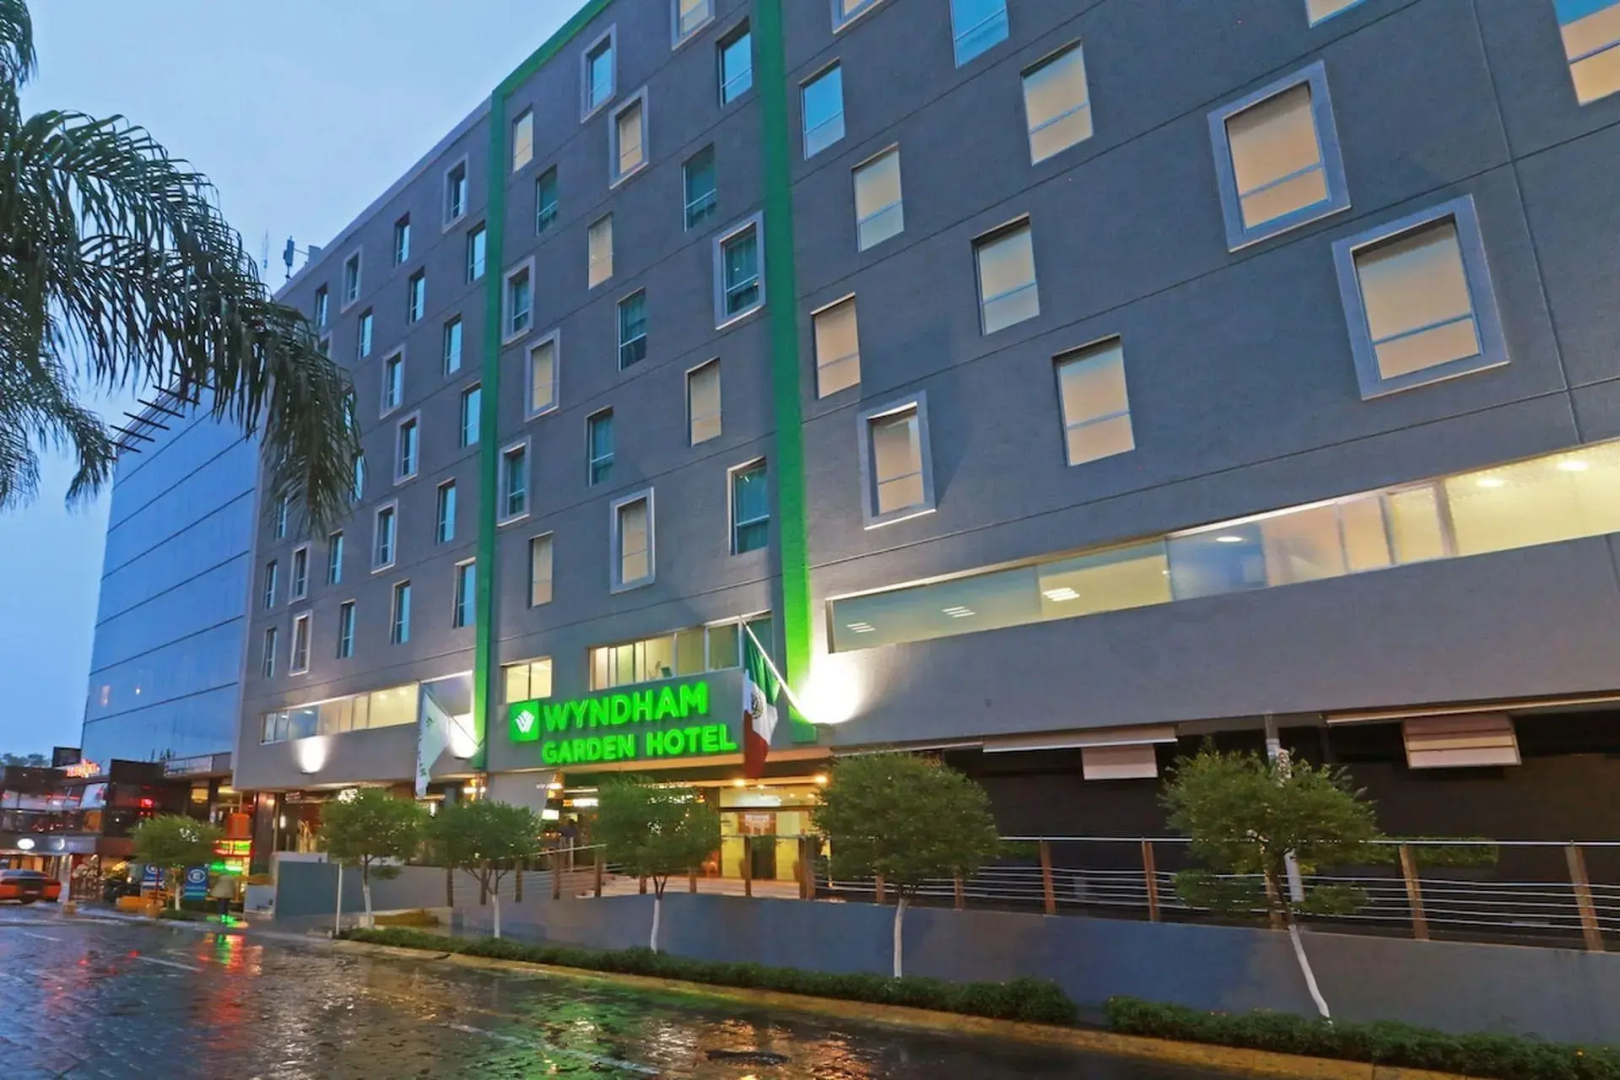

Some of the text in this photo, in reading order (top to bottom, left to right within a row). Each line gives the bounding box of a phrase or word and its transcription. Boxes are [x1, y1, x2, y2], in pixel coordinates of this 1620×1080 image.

[543, 682, 709, 732] WYNDHAM
[542, 723, 737, 763] GARDEN HOTEL
